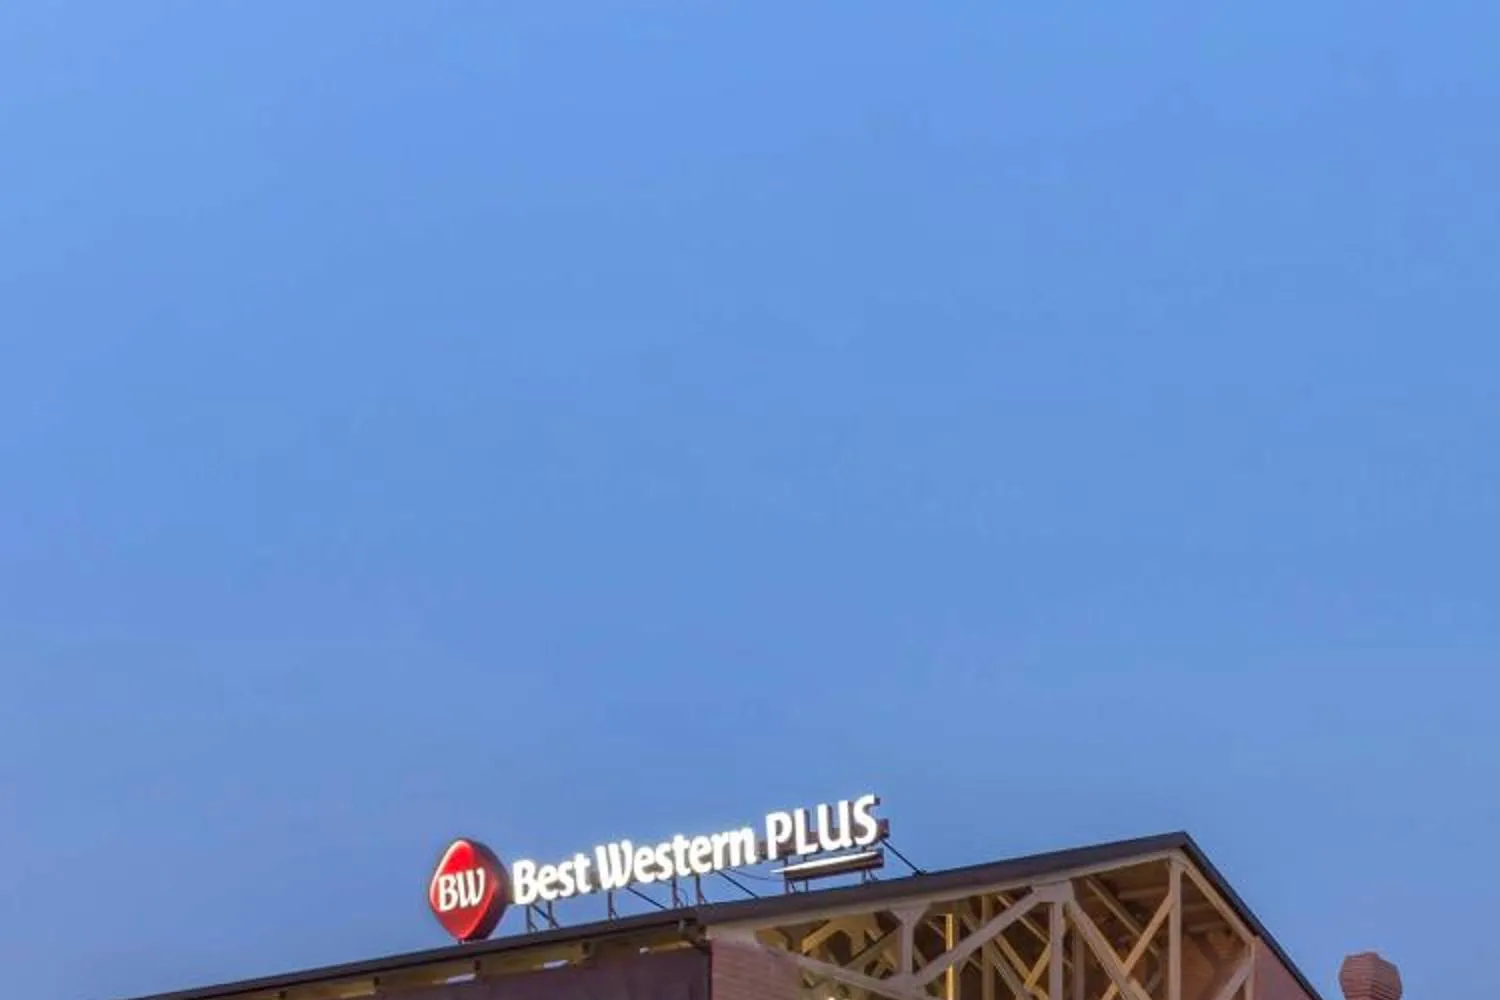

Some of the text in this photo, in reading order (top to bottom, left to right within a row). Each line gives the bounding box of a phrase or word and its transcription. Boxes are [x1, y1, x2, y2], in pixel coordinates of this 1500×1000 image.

[512, 793, 878, 905] Best Western PLUS
[438, 867, 485, 912] BW
